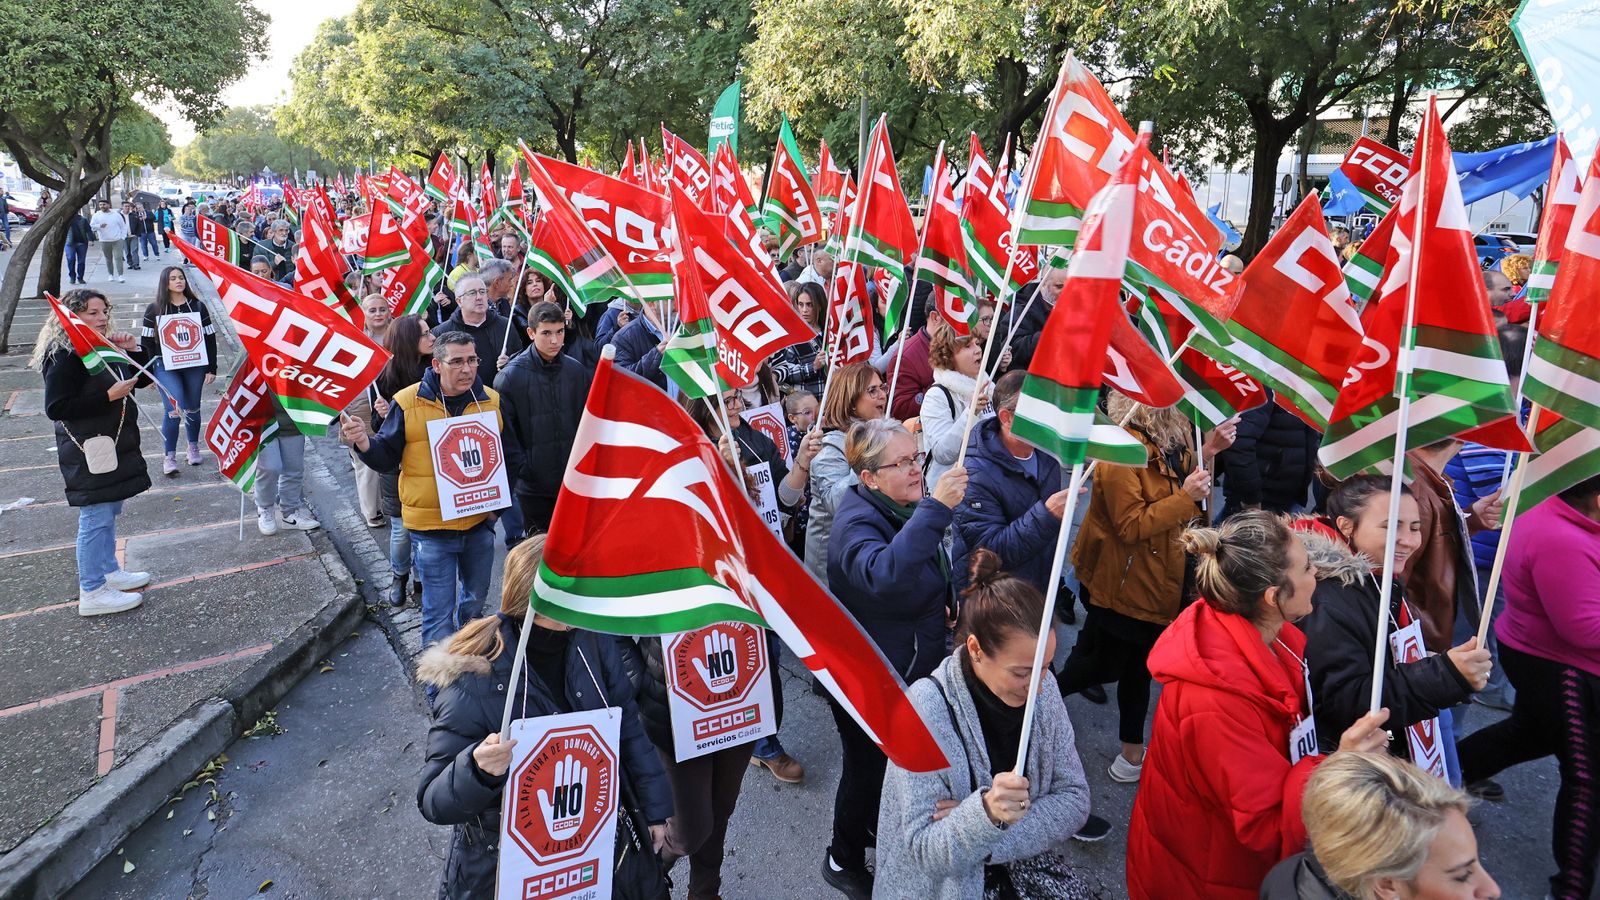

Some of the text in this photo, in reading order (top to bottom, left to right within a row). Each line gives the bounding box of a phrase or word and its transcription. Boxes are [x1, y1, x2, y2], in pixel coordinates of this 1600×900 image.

[1347, 146, 1408, 190] CCO
[1142, 218, 1238, 296] Cádiz
[177, 331, 190, 342] NO
[207, 271, 375, 379] COO
[714, 326, 749, 383] ádiz
[262, 353, 346, 398] Cádiz
[462, 449, 481, 468] NO
[456, 490, 490, 504] CCOO
[456, 505, 484, 514] servicios
[708, 650, 735, 680] NO
[746, 636, 758, 671] FESTIVOS
[696, 712, 744, 735] CCOO
[550, 742, 560, 756] DE
[564, 738, 600, 760] DOMINGOS
[696, 734, 736, 750] servicios
[521, 752, 549, 801] APERTURA
[553, 782, 582, 820] NO
[594, 768, 609, 814] FESTIVOS
[520, 806, 530, 820] LA
[524, 820, 532, 828] A
[554, 822, 574, 830] CCOO
[526, 868, 582, 900] CCOO
